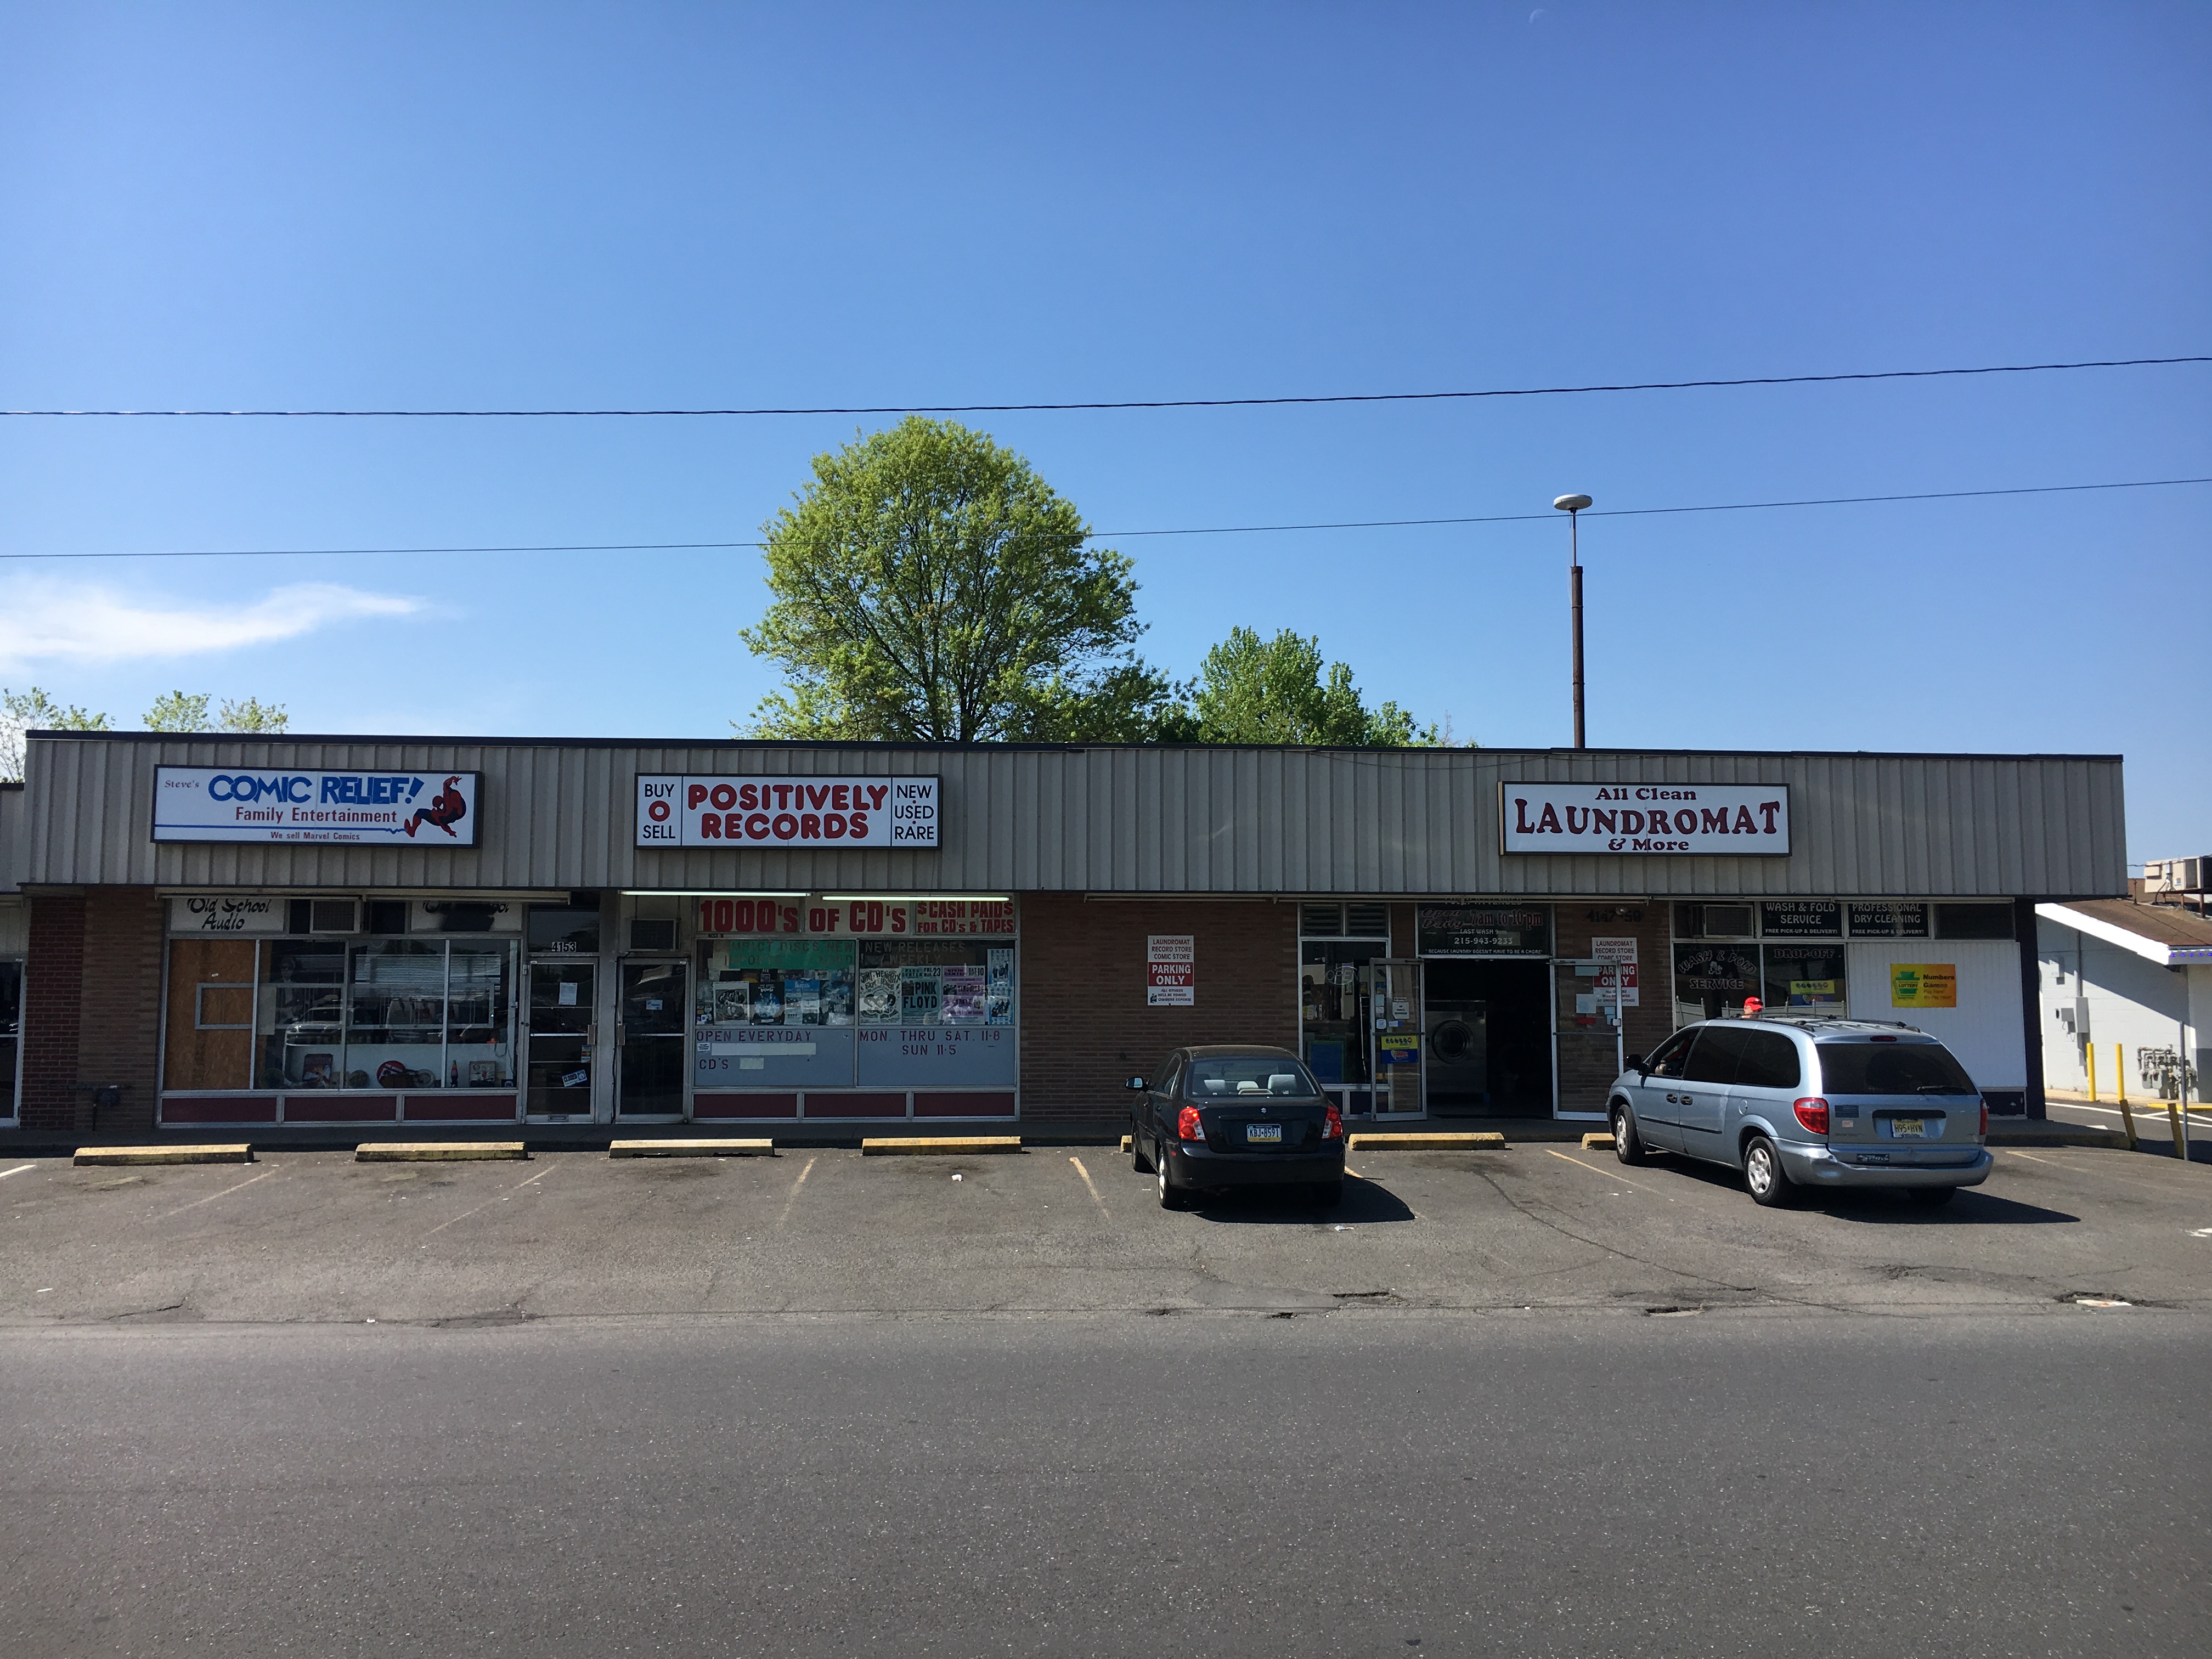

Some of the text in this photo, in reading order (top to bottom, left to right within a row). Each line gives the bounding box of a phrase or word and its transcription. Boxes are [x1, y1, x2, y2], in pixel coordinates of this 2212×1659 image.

[165, 780, 200, 789] Steve's
[208, 775, 425, 805] COMIC RELIEF!
[645, 784, 674, 798] BUY
[688, 783, 888, 811] POSITIVELY
[896, 785, 932, 799] NEW
[1595, 788, 1697, 800] All Clean
[235, 806, 397, 824] Family Entertainment
[894, 805, 934, 819] USED
[1515, 799, 1780, 835] LAUNDROMAT
[643, 825, 675, 839] SELL
[701, 812, 869, 840] RECORDS
[270, 831, 360, 840] We sell Marvel Comics
[895, 826, 934, 840] RARE
[1608, 839, 1689, 851] & More
[187, 898, 270, 913] Old School
[918, 901, 1013, 918] $CASH PAID$
[1767, 902, 1835, 912] WASH & FOLD
[701, 900, 906, 933] 1000's OF CD's
[1422, 908, 1462, 919] Open
[1780, 915, 1821, 924] SERVICE
[1854, 915, 1921, 923] DRY CLEANING
[201, 912, 245, 930] Audio
[918, 919, 1014, 933] FOR CD's & TAPES
[1422, 919, 1464, 929] Daily
[551, 941, 576, 952] 4153
[714, 941, 773, 952] CMPACT
[827, 941, 853, 952] NEW
[865, 941, 966, 953] NEW RELEASES
[1774, 949, 1835, 958] DROP-OFF
[890, 955, 942, 966] WEEKLY
[1678, 950, 1756, 974] WASH & FOLD
[933, 967, 941, 977] 23
[978, 968, 984, 976] 10
[1152, 964, 1190, 974] PARKING
[1599, 966, 1635, 975] PARING
[1156, 975, 1184, 985] ONLY
[1601, 977, 1629, 986] ONY
[1689, 978, 1744, 990] SERVICE
[915, 981, 936, 995] PINK
[904, 996, 937, 1008] FLOYD
[696, 1030, 812, 1042] OPEN EVERYDAY
[859, 1030, 892, 1042] MON.
[900, 1030, 936, 1042] THRU
[902, 1045, 928, 1056] SUN
[699, 1057, 729, 1070] CD'S
